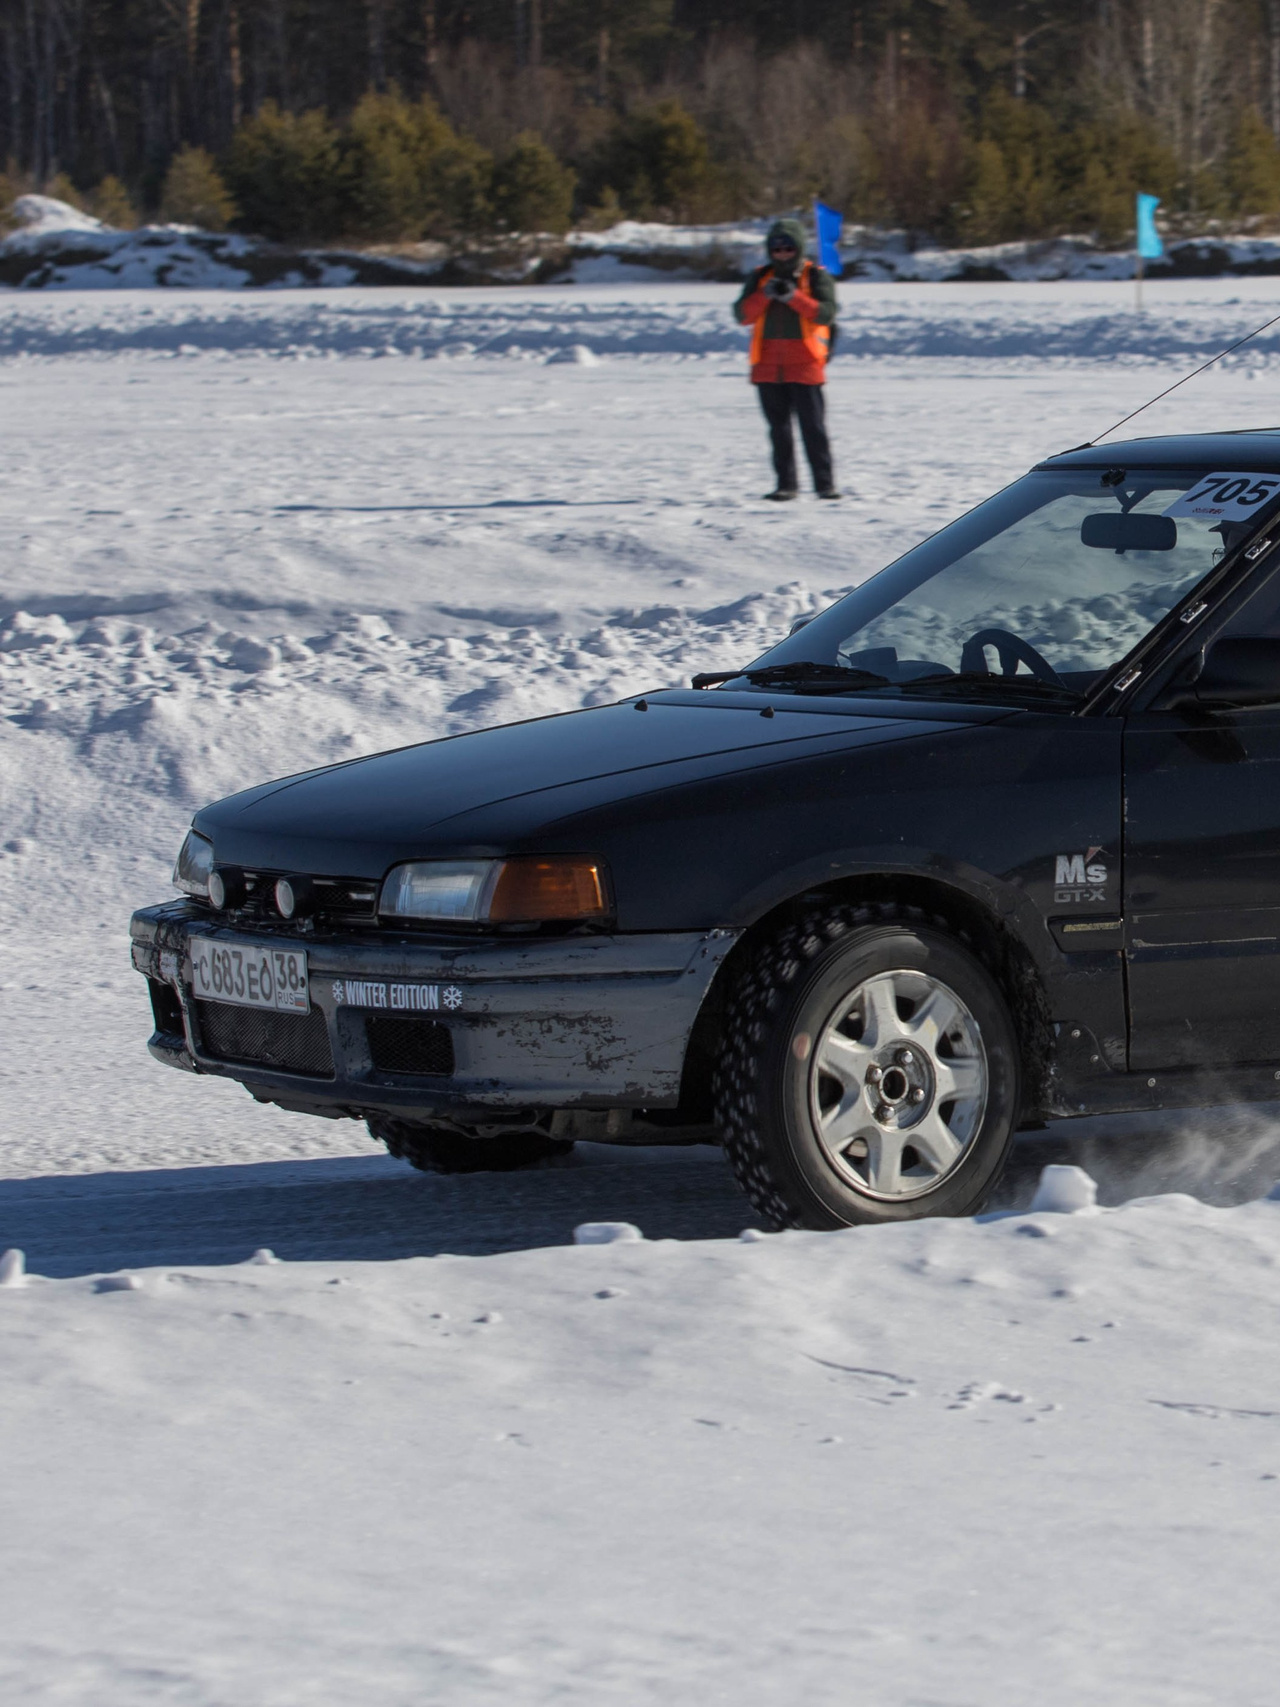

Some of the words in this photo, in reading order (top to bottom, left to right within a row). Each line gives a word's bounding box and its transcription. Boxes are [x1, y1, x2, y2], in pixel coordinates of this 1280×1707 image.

[1185, 477, 1280, 505] 705
[1054, 888, 1106, 903] GT-X
[275, 953, 299, 992] 38
[277, 992, 295, 1006] RUS
[345, 980, 388, 1008] WINTER
[390, 983, 439, 1010] EDITION
